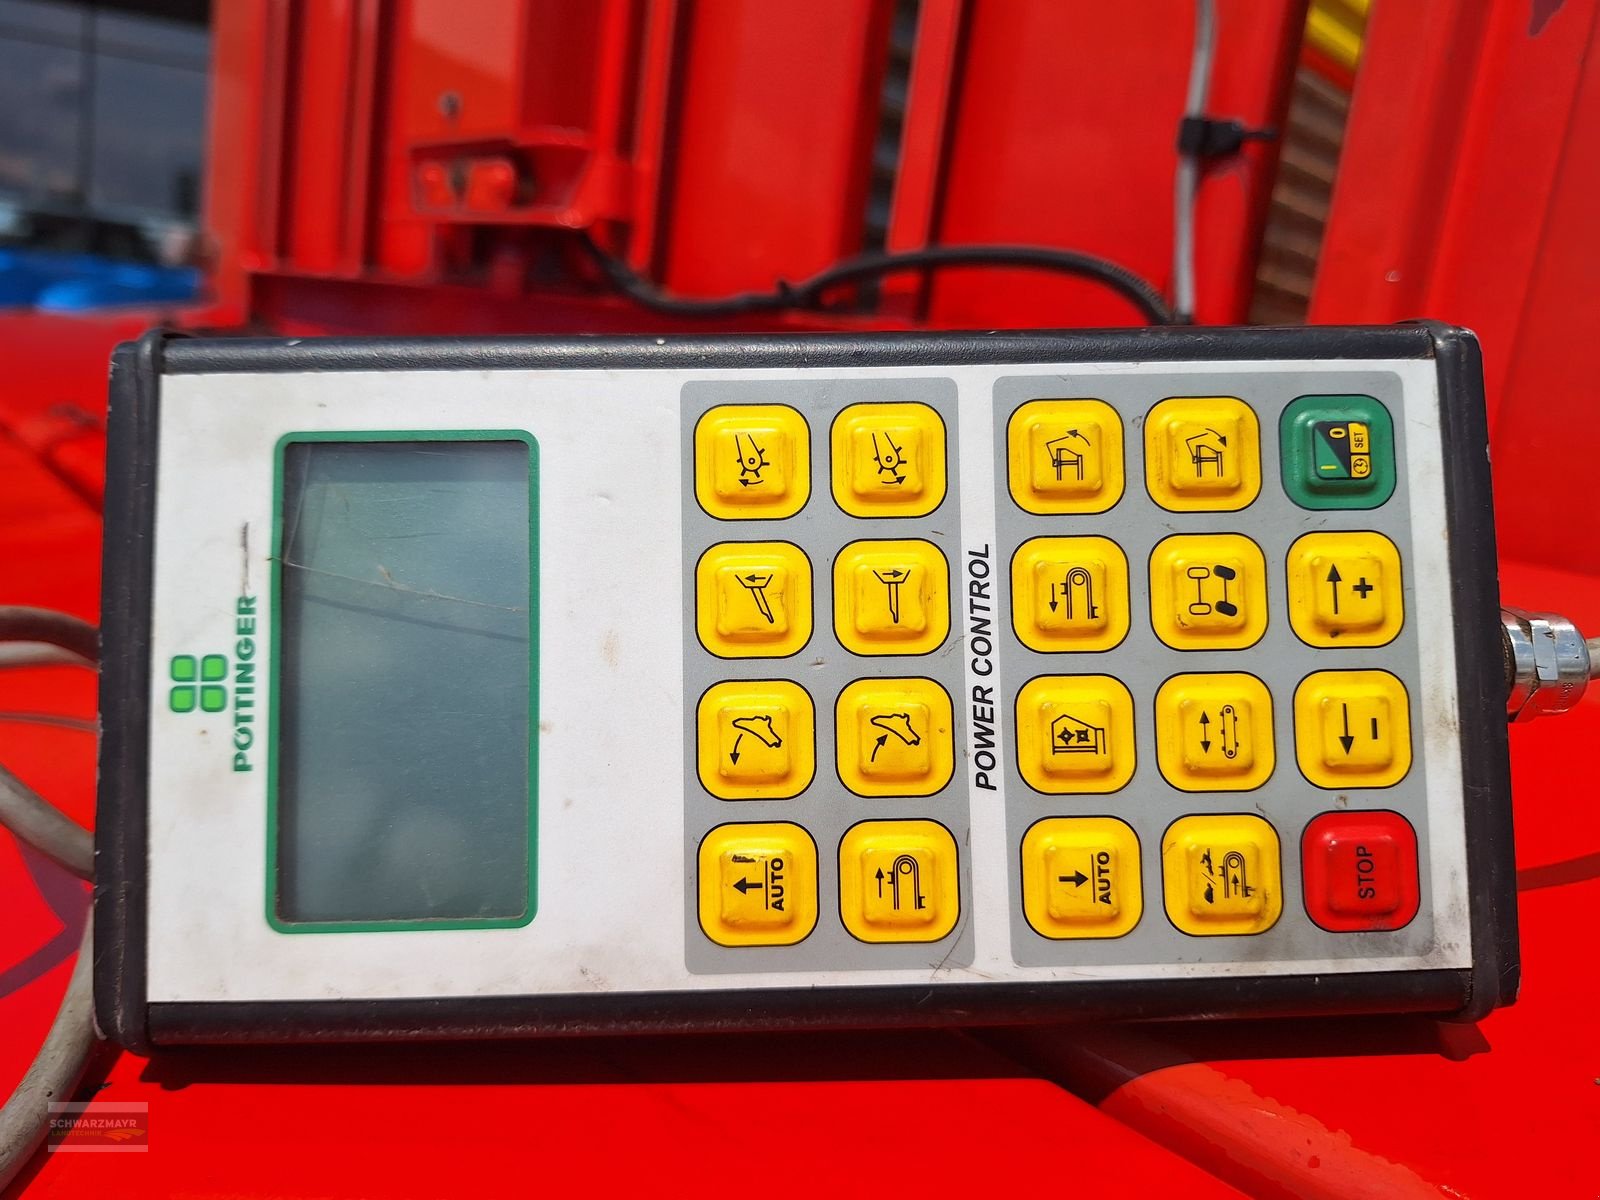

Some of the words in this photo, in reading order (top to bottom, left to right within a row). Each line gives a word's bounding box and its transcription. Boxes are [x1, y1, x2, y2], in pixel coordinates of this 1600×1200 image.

[1354, 432, 1364, 448] SET
[968, 544, 993, 676] CONTROL
[974, 686, 997, 791] POWER
[770, 857, 785, 912] AUTO
[1097, 851, 1112, 905] AUTO
[1356, 846, 1376, 899] STOP
